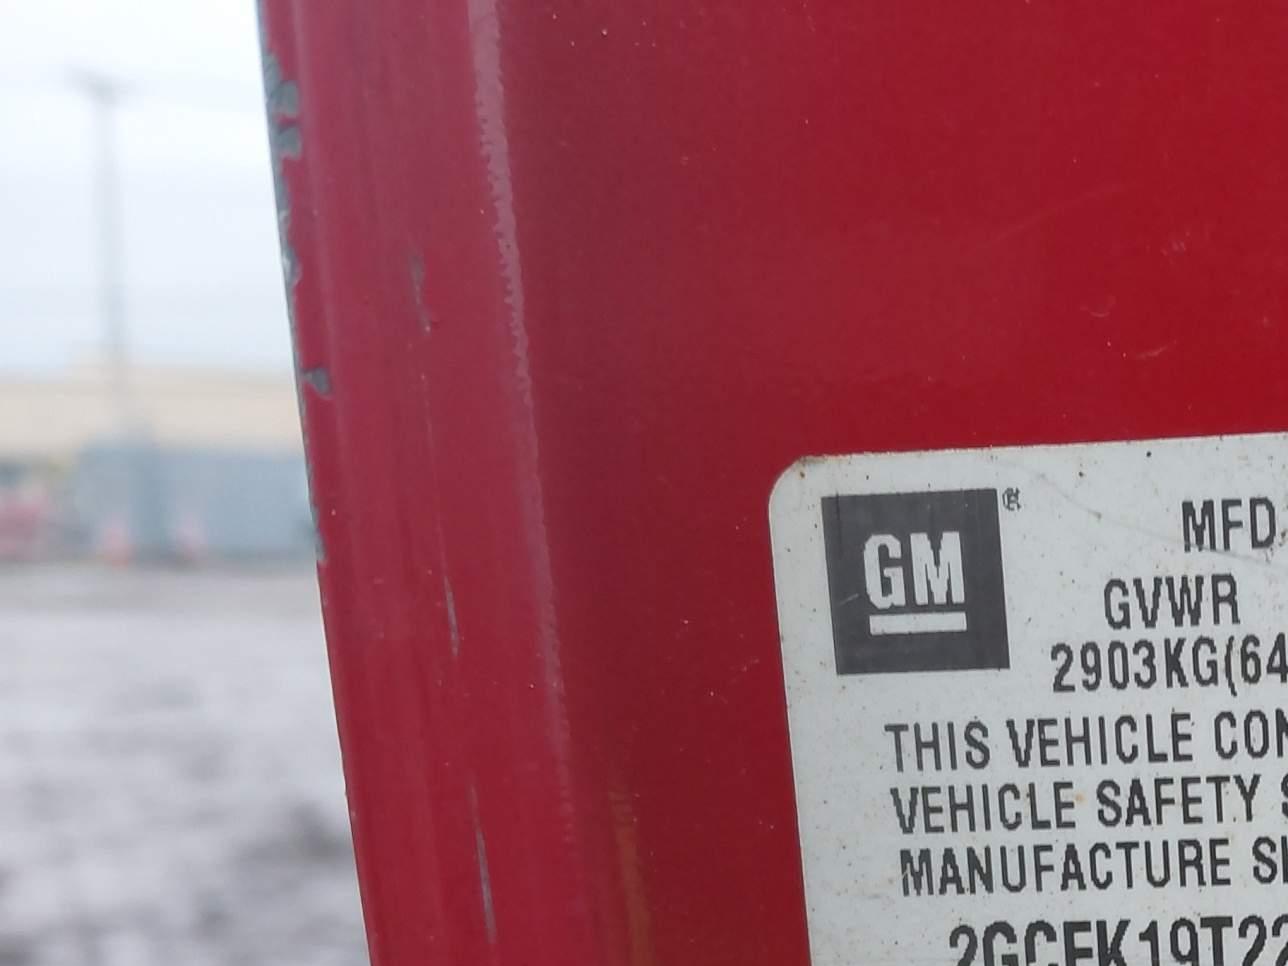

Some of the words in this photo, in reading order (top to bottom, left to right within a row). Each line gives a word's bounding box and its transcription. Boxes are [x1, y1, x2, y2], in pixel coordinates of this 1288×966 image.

[1182, 498, 1276, 552] MFD
[865, 531, 966, 609] GM
[1103, 573, 1240, 630] GVWR
[885, 721, 990, 772] THIS
[1007, 712, 1193, 768] VEHICLE
[891, 780, 1076, 836] VEHICLE
[1097, 774, 1262, 827] SAFETY
[900, 838, 1231, 896] MANUFACTURE
